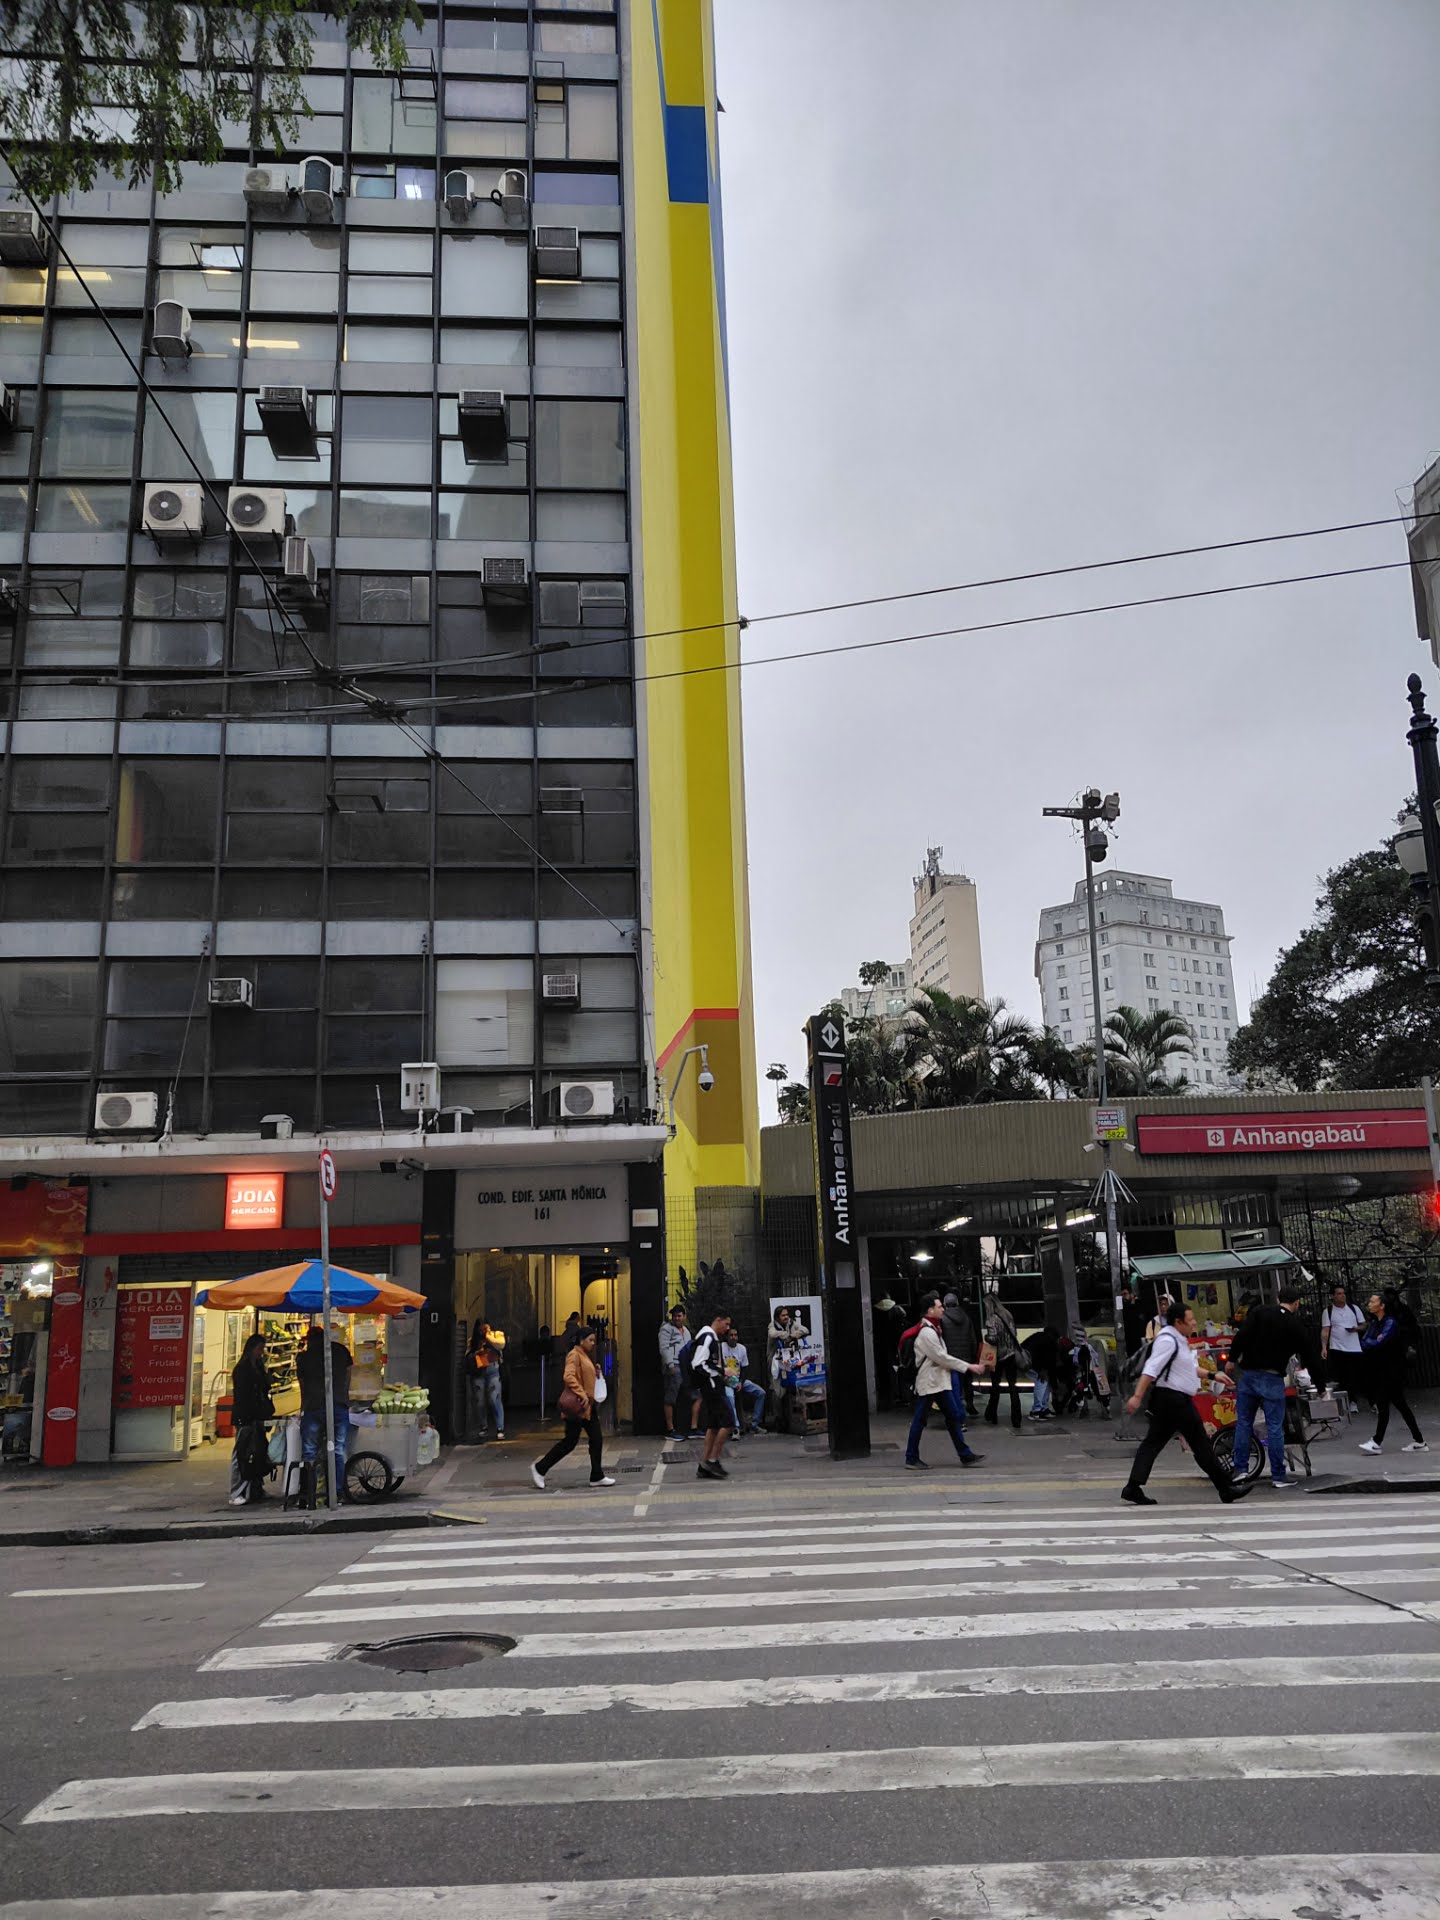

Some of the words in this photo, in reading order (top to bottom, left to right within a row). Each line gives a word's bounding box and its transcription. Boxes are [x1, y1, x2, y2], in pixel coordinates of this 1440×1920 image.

[1232, 1125, 1366, 1148] Anhangabaú
[827, 1103, 850, 1245] Anhangabaú
[231, 1190, 276, 1203] JOIA
[478, 1191, 506, 1205] COND.
[512, 1190, 534, 1203] EDIF.
[539, 1188, 567, 1202] SANTA
[571, 1185, 607, 1201] MÔNICA
[231, 1207, 276, 1215] MERCADO
[534, 1207, 550, 1220] 161
[120, 1289, 182, 1305] JOIA
[119, 1304, 183, 1313] MERCADO
[152, 1344, 178, 1353] Frios
[148, 1359, 181, 1368] Frutas
[140, 1375, 185, 1384] Verduras
[139, 1393, 185, 1403] Legumes
